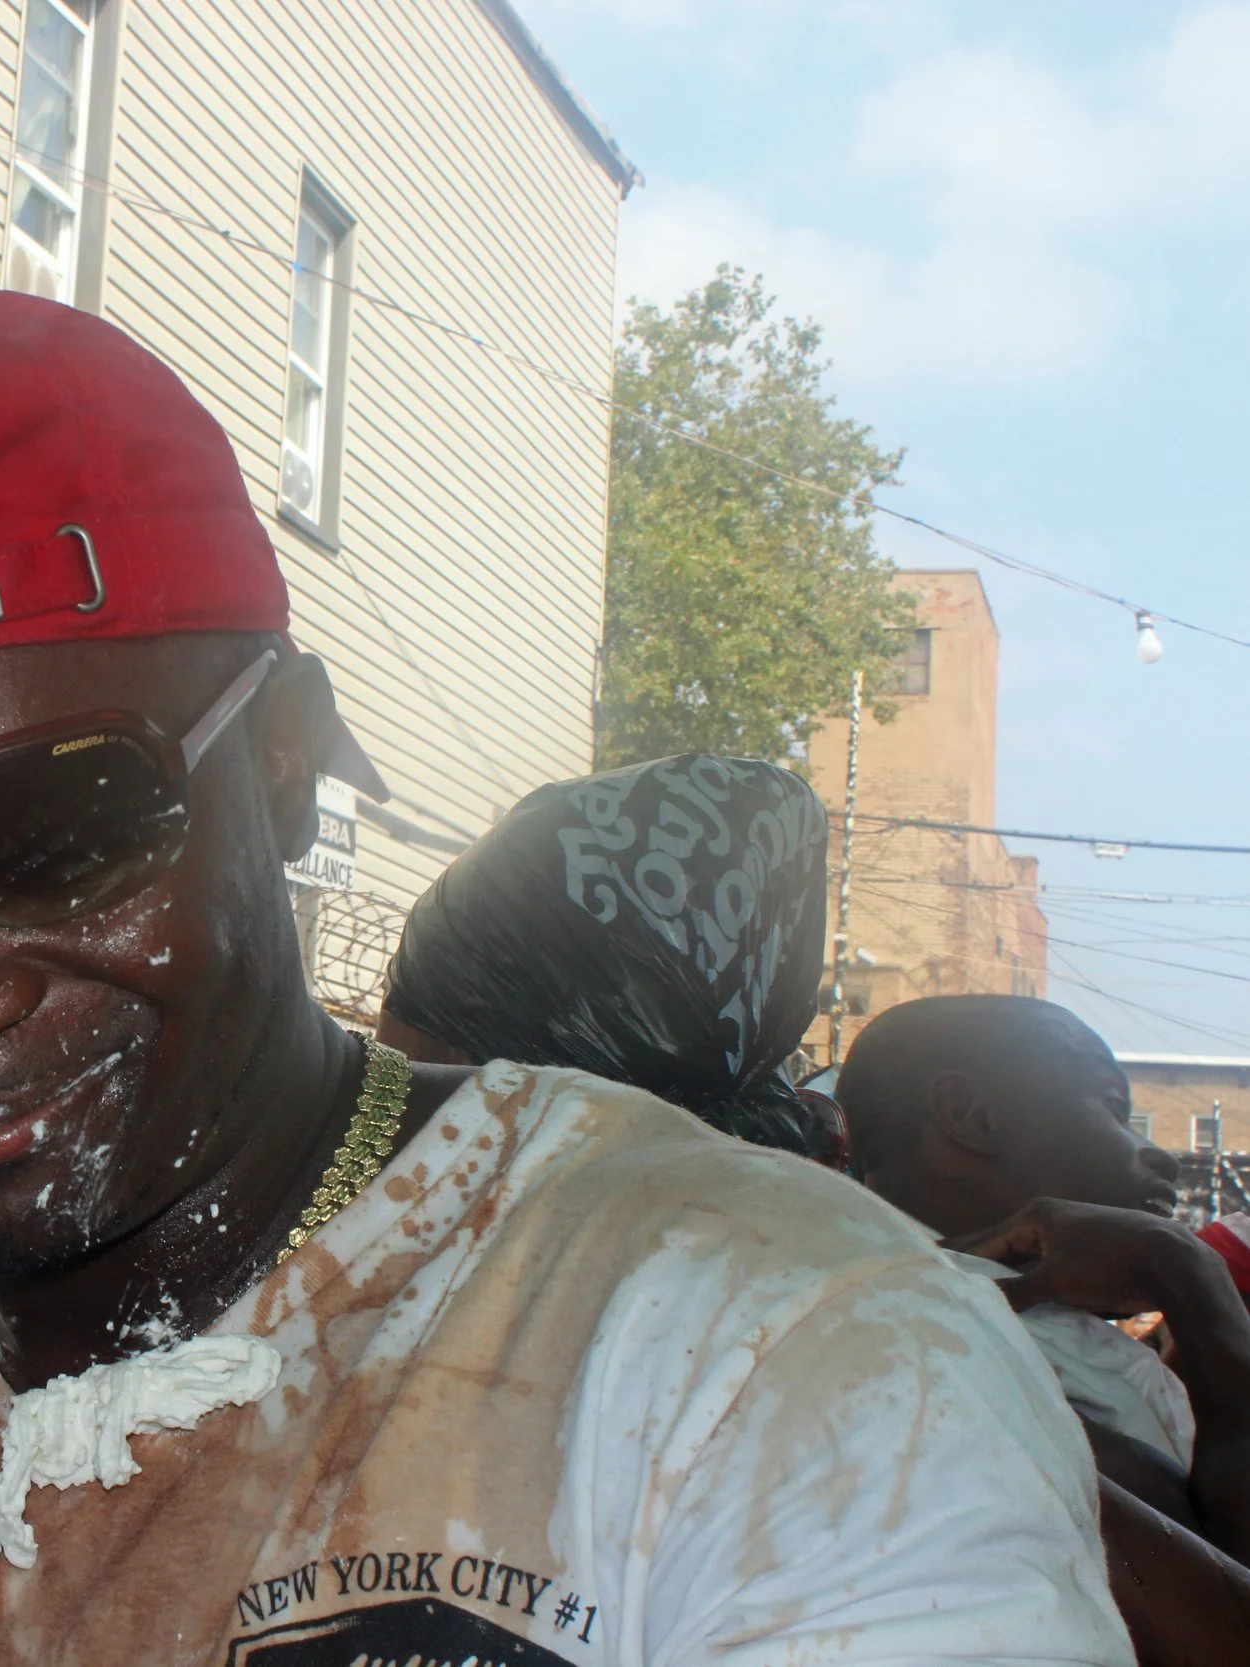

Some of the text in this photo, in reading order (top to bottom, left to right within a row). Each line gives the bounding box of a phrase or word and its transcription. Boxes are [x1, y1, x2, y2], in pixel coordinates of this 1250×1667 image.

[52, 734, 105, 756] CARRERA
[319, 813, 351, 848] ERA
[285, 851, 354, 889] ILLANCE
[236, 1552, 599, 1644] NEW YORK CITY #1
